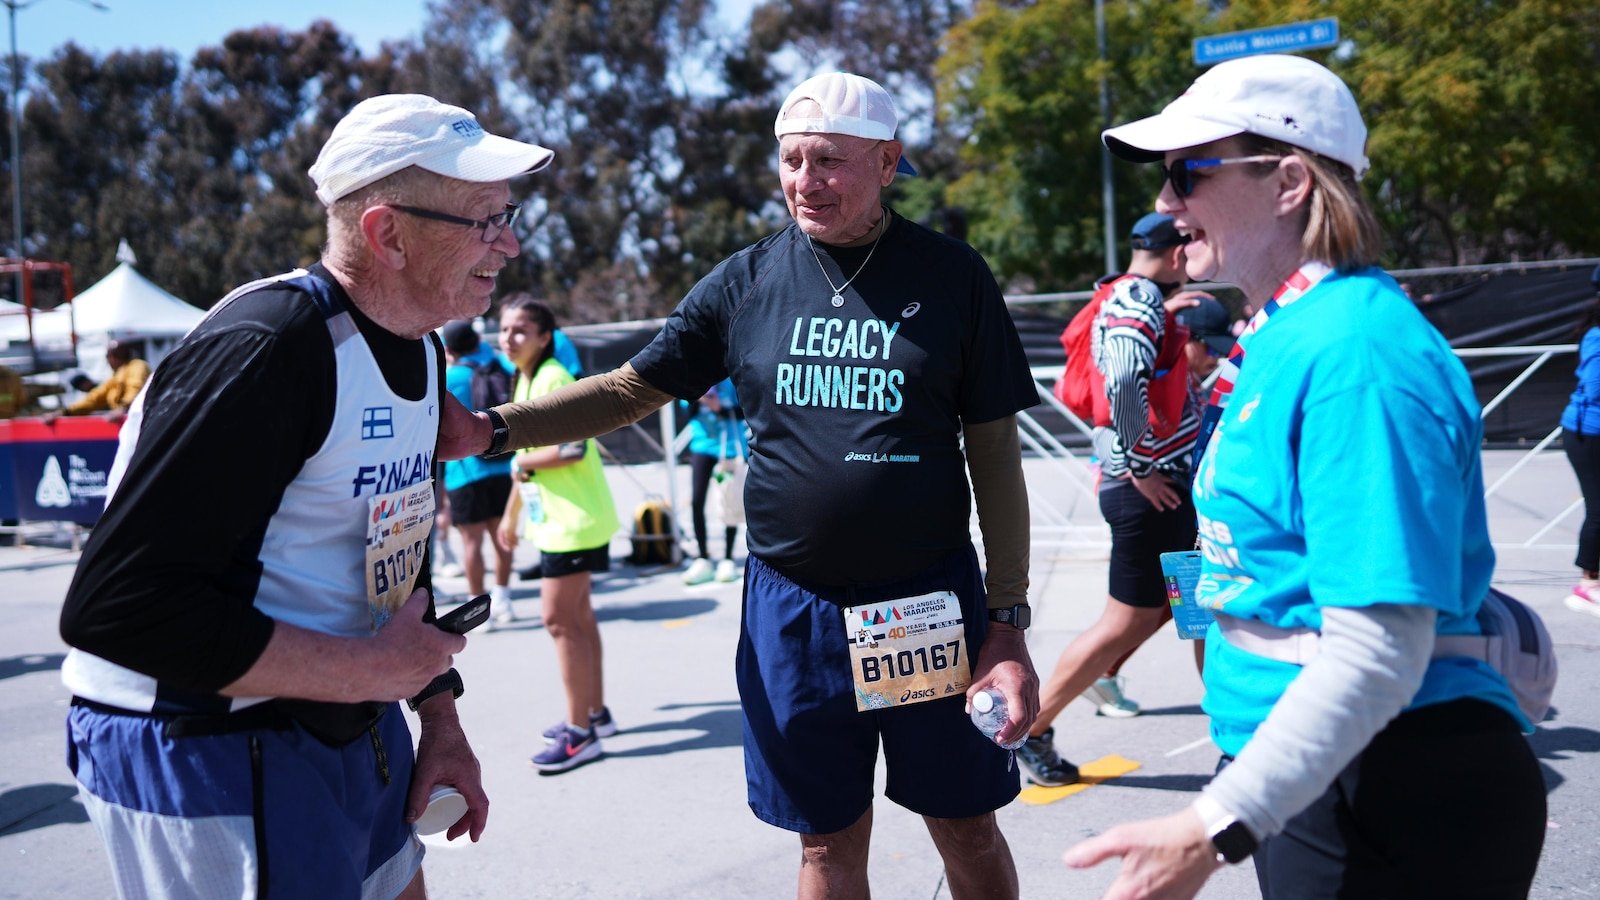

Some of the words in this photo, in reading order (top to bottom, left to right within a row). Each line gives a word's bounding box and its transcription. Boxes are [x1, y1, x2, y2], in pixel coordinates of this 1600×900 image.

[1204, 39, 1247, 56] Santa
[1251, 30, 1308, 49] Monica
[789, 317, 901, 360] LEGACY
[775, 362, 905, 413] RUNNERS
[889, 454, 920, 463] MARATHON
[352, 450, 433, 498] FINLAN
[903, 604, 946, 617] MARATHON
[916, 598, 945, 609] ANGELES
[888, 626, 907, 640] 40
[906, 622, 927, 630] YEARS
[861, 640, 960, 683] B10167
[911, 688, 935, 699] asics
